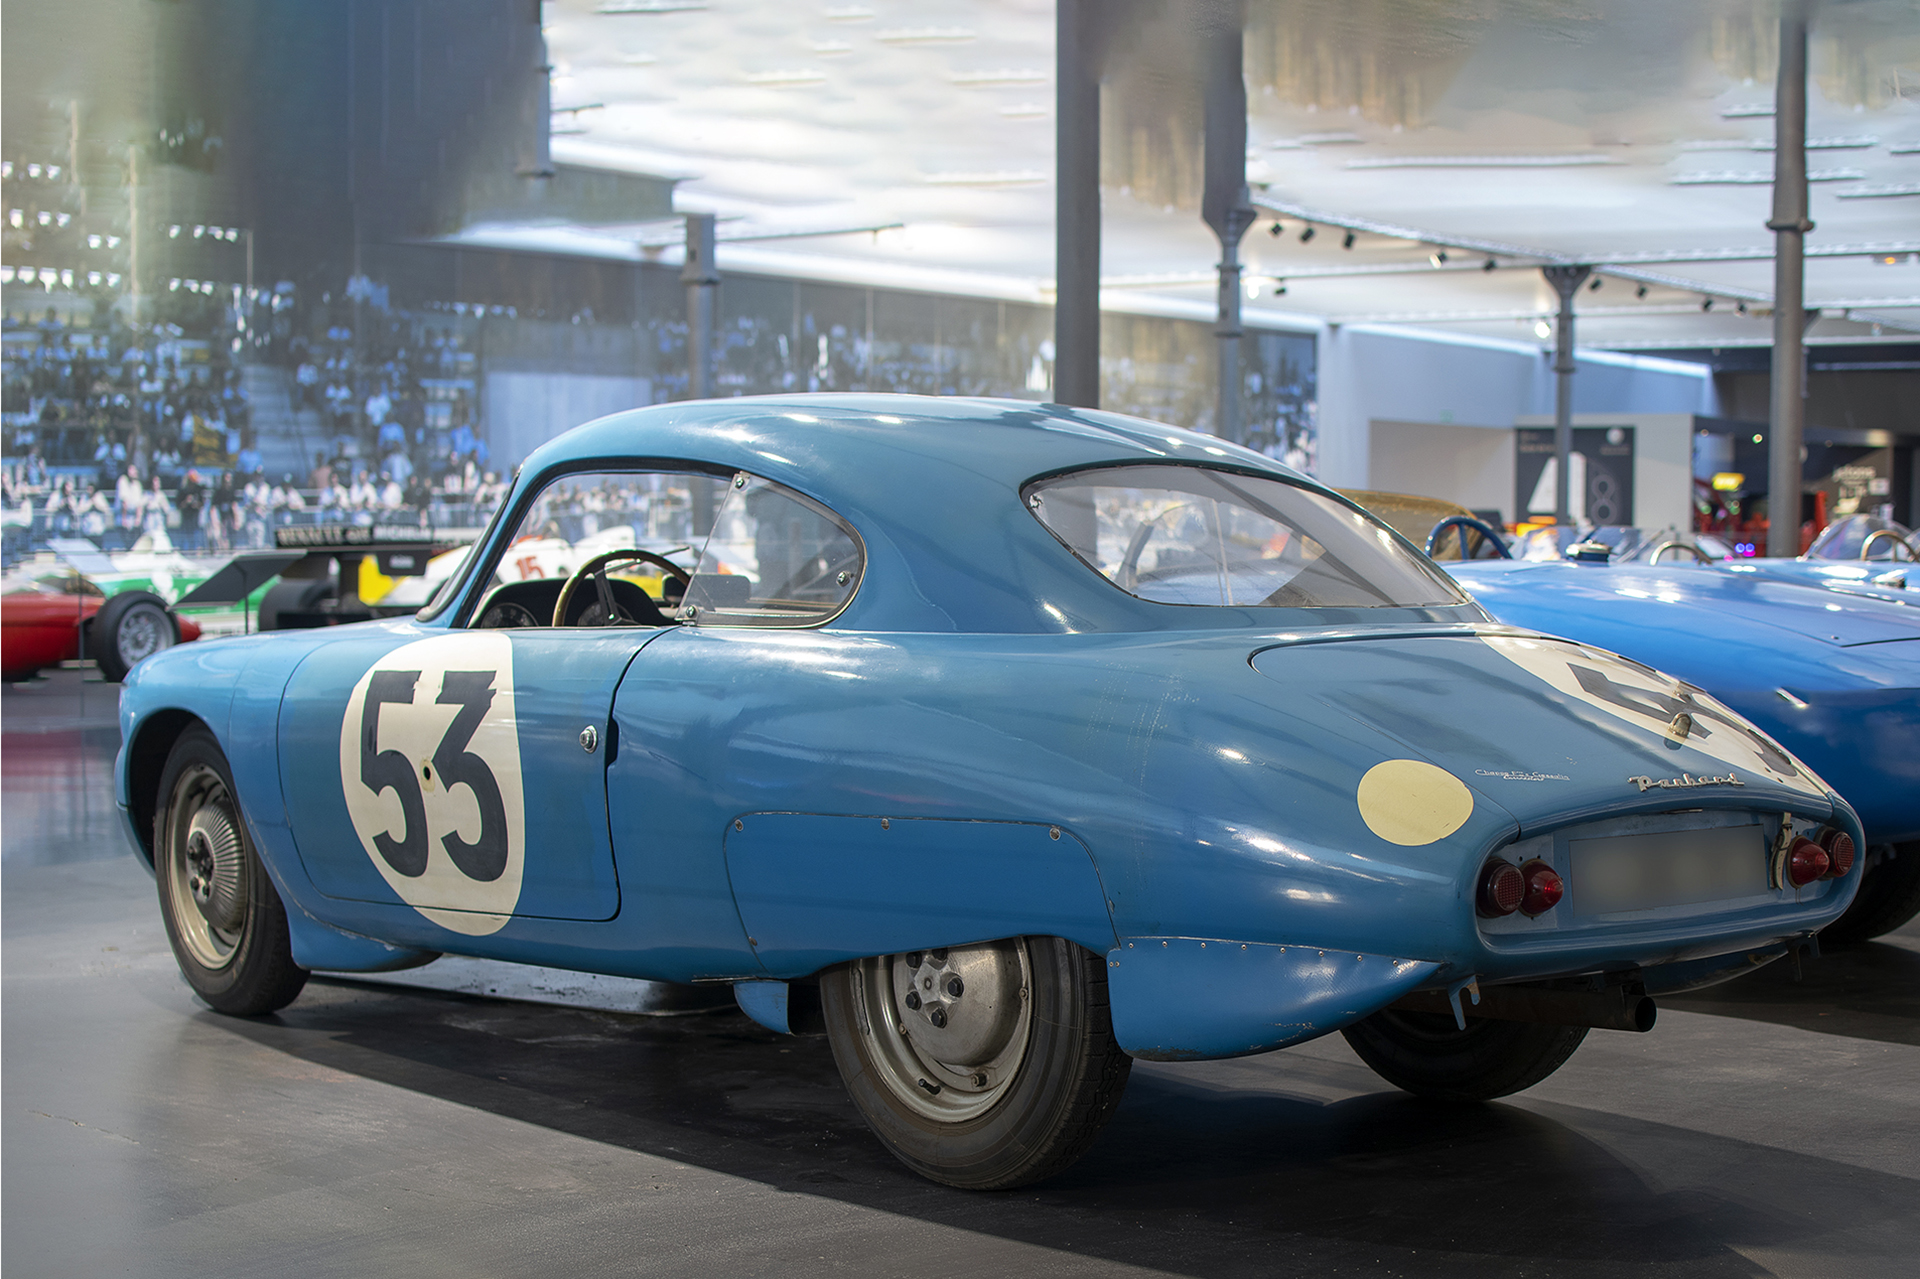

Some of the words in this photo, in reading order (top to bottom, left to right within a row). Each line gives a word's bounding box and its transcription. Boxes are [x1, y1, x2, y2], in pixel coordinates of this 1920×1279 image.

[516, 556, 545, 580] 15
[360, 669, 508, 882] 53
[1627, 773, 1745, 792] Panhard
